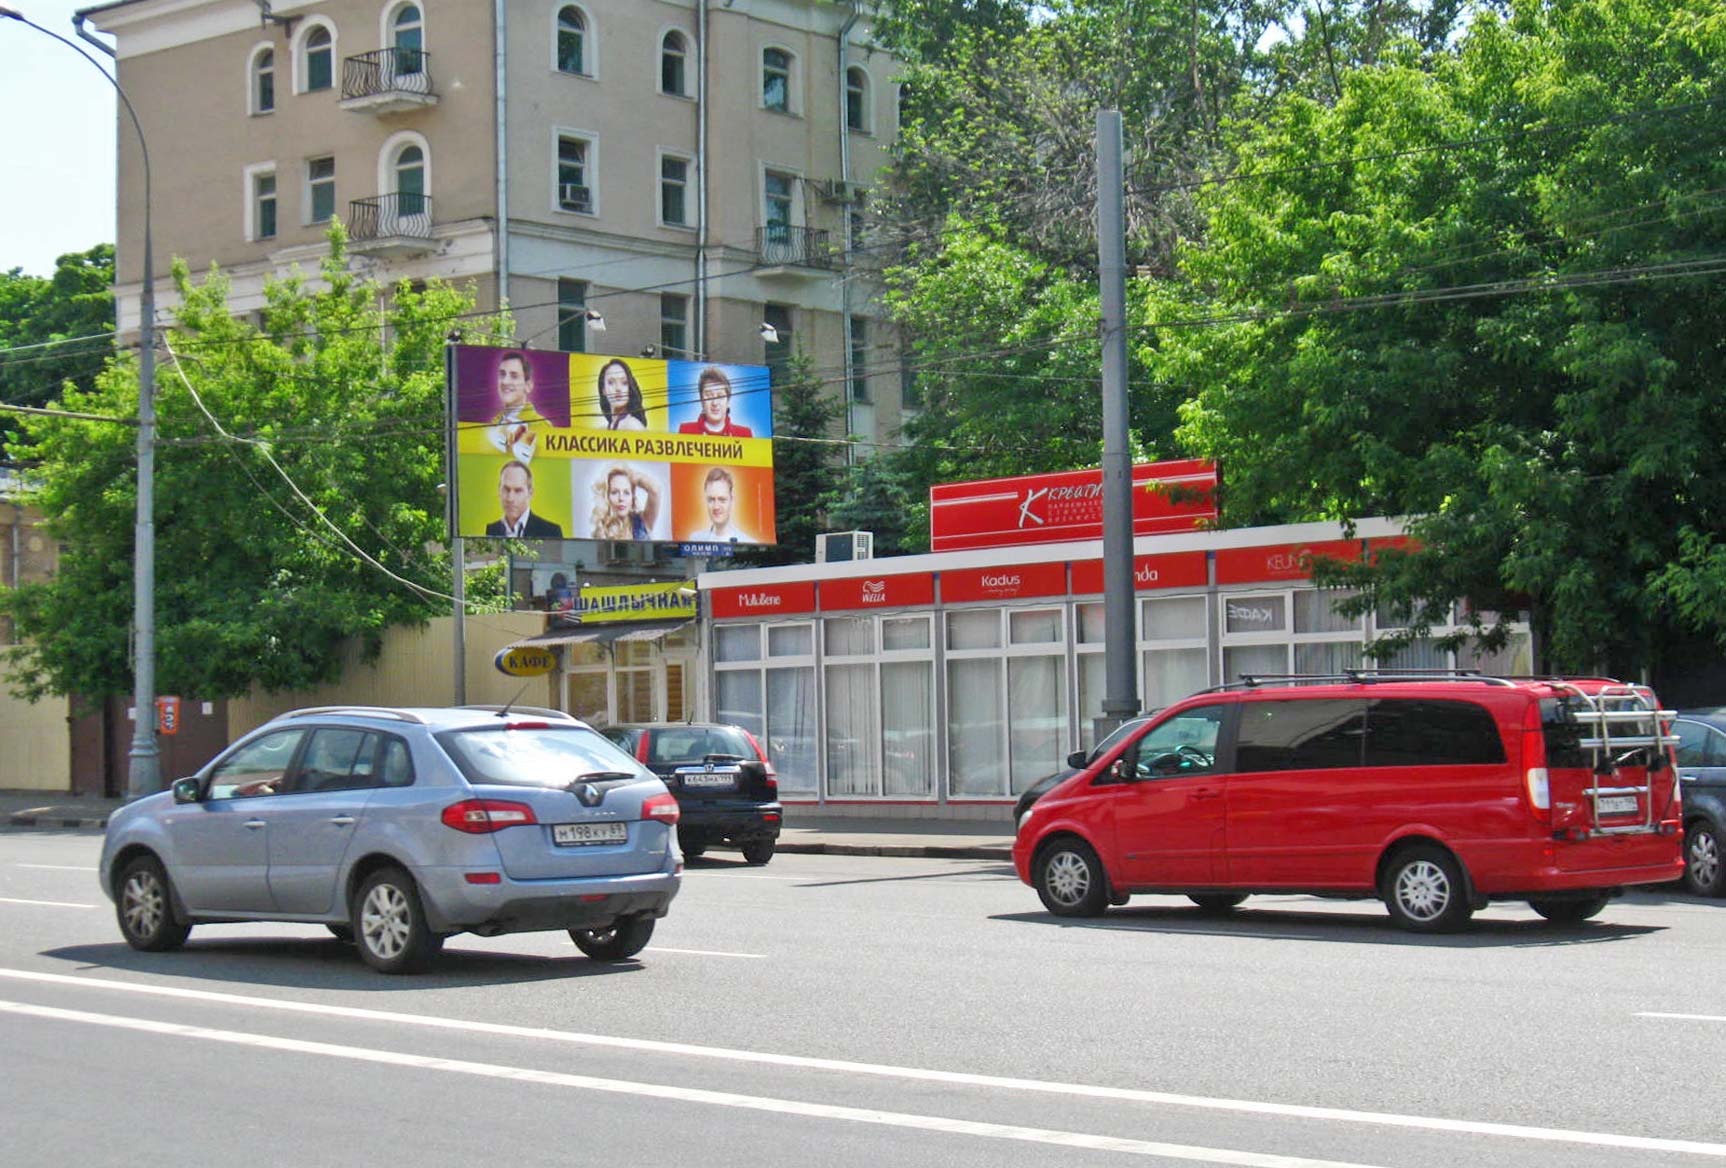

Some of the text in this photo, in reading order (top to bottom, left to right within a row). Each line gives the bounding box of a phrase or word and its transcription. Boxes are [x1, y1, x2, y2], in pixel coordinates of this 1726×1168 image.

[545, 434, 743, 460] КЛАССИКА РАЗВЛЕЧЕНИЙ
[683, 544, 719, 552] ОЛИМП
[981, 574, 1021, 587] Kadus
[573, 591, 692, 612] ШАШЛЫЧНАЯ
[862, 593, 886, 603] WELLA
[509, 655, 550, 669] КАФЕ
